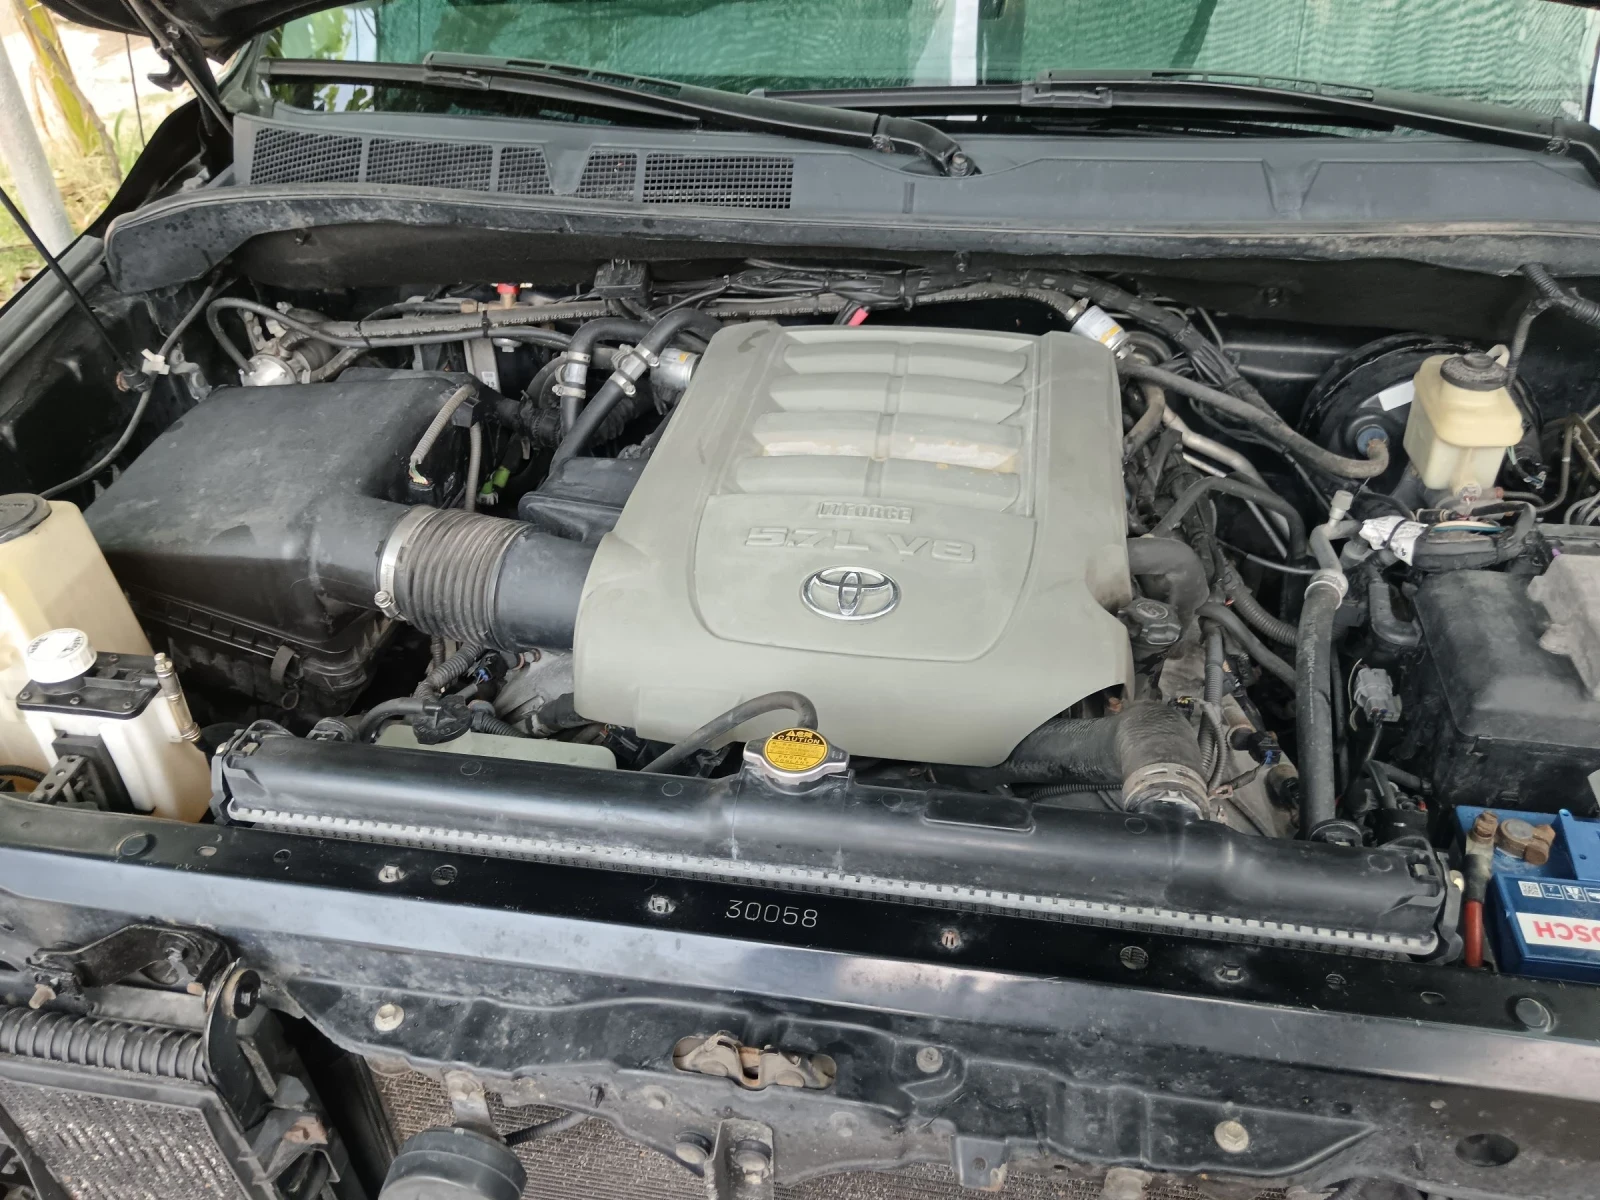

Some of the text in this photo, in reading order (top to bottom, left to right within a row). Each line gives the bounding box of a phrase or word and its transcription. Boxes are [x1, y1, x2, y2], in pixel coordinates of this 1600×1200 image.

[744, 527, 976, 563] 5.7L V8
[777, 735, 821, 744] CAUTION
[725, 899, 818, 928] 30058
